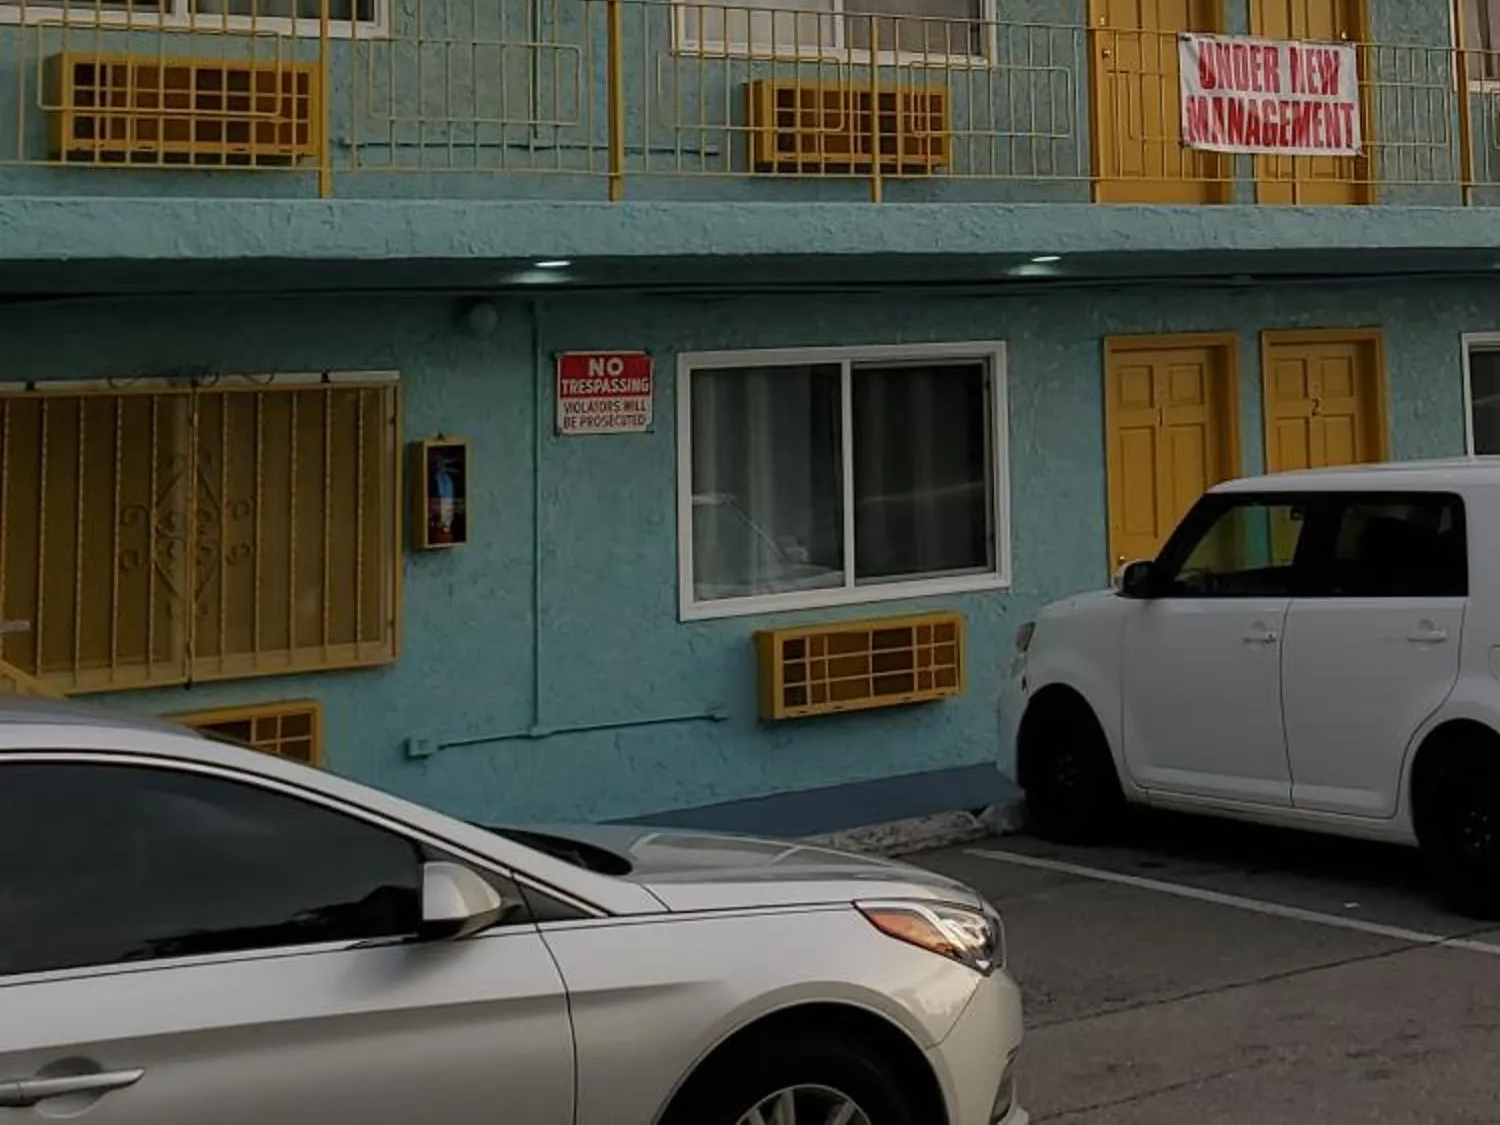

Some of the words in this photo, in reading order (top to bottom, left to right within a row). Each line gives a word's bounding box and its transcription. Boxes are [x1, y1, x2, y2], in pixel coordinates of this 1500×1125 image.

[1197, 40, 1281, 94] UNDER
[1288, 46, 1341, 96] NEW
[1185, 95, 1355, 149] MANAGEMENT
[588, 356, 625, 377] NO
[561, 377, 650, 396] TRESPASSING
[563, 400, 622, 414] VIOLATORS
[623, 399, 647, 413] WILL
[1311, 398, 1320, 417] 2
[563, 415, 577, 429] BE
[579, 413, 645, 429] PROSECUTED
